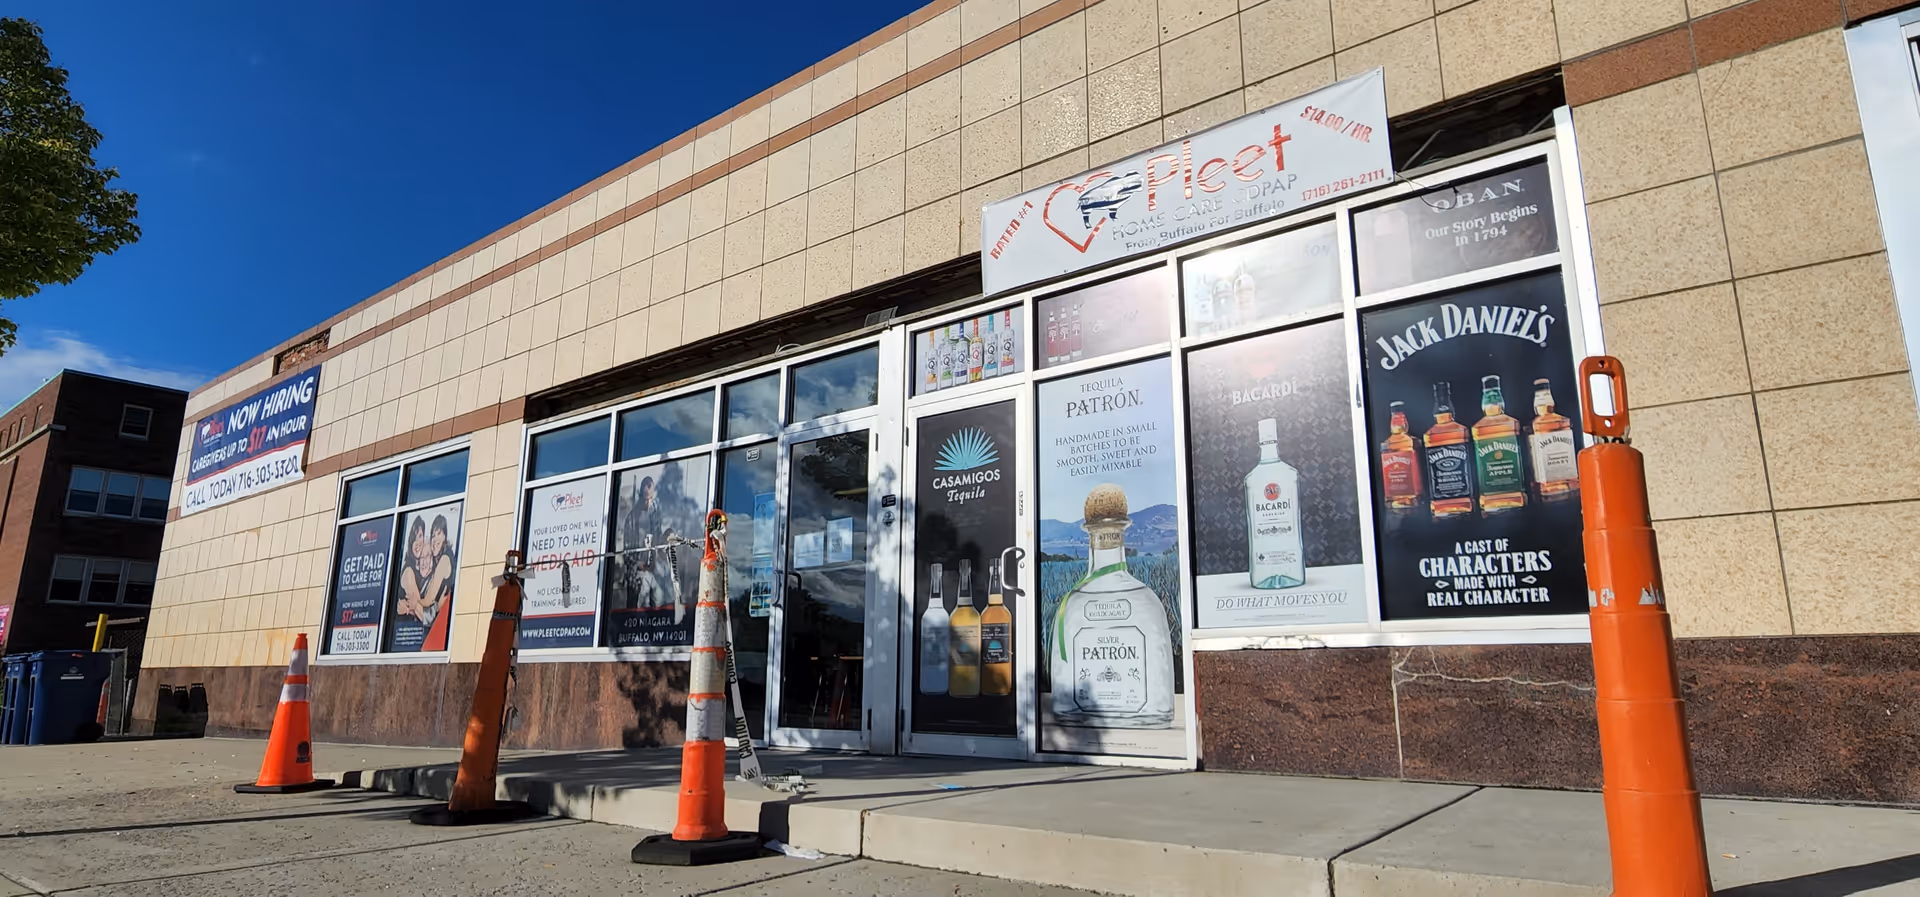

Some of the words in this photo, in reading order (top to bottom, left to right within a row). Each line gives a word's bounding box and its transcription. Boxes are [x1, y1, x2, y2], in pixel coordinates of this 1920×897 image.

[1300, 105, 1344, 131] $14.00
[1147, 123, 1292, 212] Pleet
[1431, 178, 1523, 214] OBAN
[1112, 211, 1166, 241] HOME
[1173, 195, 1224, 222] CARE
[1209, 214, 1230, 229] For
[1234, 198, 1286, 221] Buffalo
[1424, 226, 1449, 240] Our
[1452, 215, 1487, 234] Story
[1490, 203, 1539, 226] Begins
[990, 218, 1021, 260] RATED
[1017, 200, 1034, 220] #1
[1454, 234, 1469, 247] In
[1474, 225, 1508, 243] 1794
[1375, 315, 1442, 371] JACK
[1440, 302, 1556, 345] DANIEL'S
[1080, 376, 1124, 394] TEQUILA
[1232, 377, 1298, 407] BACARDÍ
[227, 398, 262, 436] NOW
[261, 375, 315, 421] HIRING
[1066, 387, 1140, 418] PATRÓN
[227, 442, 238, 458] UP
[237, 439, 248, 454] TO
[246, 424, 268, 455] $17
[265, 424, 281, 443] AN
[280, 414, 307, 438] HOUR
[1055, 429, 1110, 447] HANDMADE
[1112, 426, 1124, 437] IN
[1126, 421, 1158, 435] SMALL
[1056, 454, 1100, 468] SMOOTH,
[1101, 449, 1132, 462] SWEET
[1133, 444, 1157, 457] AND
[1070, 441, 1111, 455] BATCHES
[1113, 438, 1127, 448] TO
[1130, 436, 1141, 446] BE
[1070, 464, 1100, 477] EASILY
[1101, 458, 1142, 473] MIXABLE
[186, 483, 206, 508] CALL
[208, 472, 238, 502] TODAY
[932, 469, 1001, 490] CASAMIGOS
[946, 488, 986, 505] Tequila
[1255, 498, 1292, 512] BACARDÍ
[533, 527, 548, 536] YOUR
[549, 524, 568, 534] LOVED
[569, 521, 582, 531] ONE
[584, 519, 598, 528] WILL
[532, 538, 555, 552] NEED
[558, 535, 570, 549] TO
[572, 531, 597, 547] HAVE
[1455, 542, 1463, 555] A
[1464, 539, 1492, 554] CAST
[1495, 538, 1509, 551] OF
[344, 556, 362, 574] GET
[362, 552, 385, 571] PAID
[1419, 550, 1553, 578] CHARACTERS
[342, 574, 351, 585] TO
[351, 571, 368, 584] CARE
[368, 570, 382, 582] FOR
[1454, 575, 1485, 590] MADE
[1486, 574, 1516, 588] WITH
[537, 588, 546, 596] NO
[571, 585, 580, 594] OR
[1216, 599, 1234, 611] DO
[1235, 595, 1272, 610] WHAT
[1274, 593, 1320, 607] MOVES
[1320, 591, 1348, 605] YOU
[1427, 591, 1462, 607] REAL
[1464, 587, 1551, 606] CHARACTER
[531, 599, 557, 609] TRAINING
[623, 617, 638, 627] 420
[639, 615, 671, 627] NIAGARA
[336, 631, 350, 641] CALL
[352, 629, 372, 640] TODAY
[618, 630, 652, 643] BUFFALO,
[653, 631, 664, 641] NY
[665, 630, 687, 641] 14201
[1097, 636, 1119, 645] SILVER
[1082, 643, 1137, 661] PATRÓN
[735, 716, 753, 759] CAUTION
